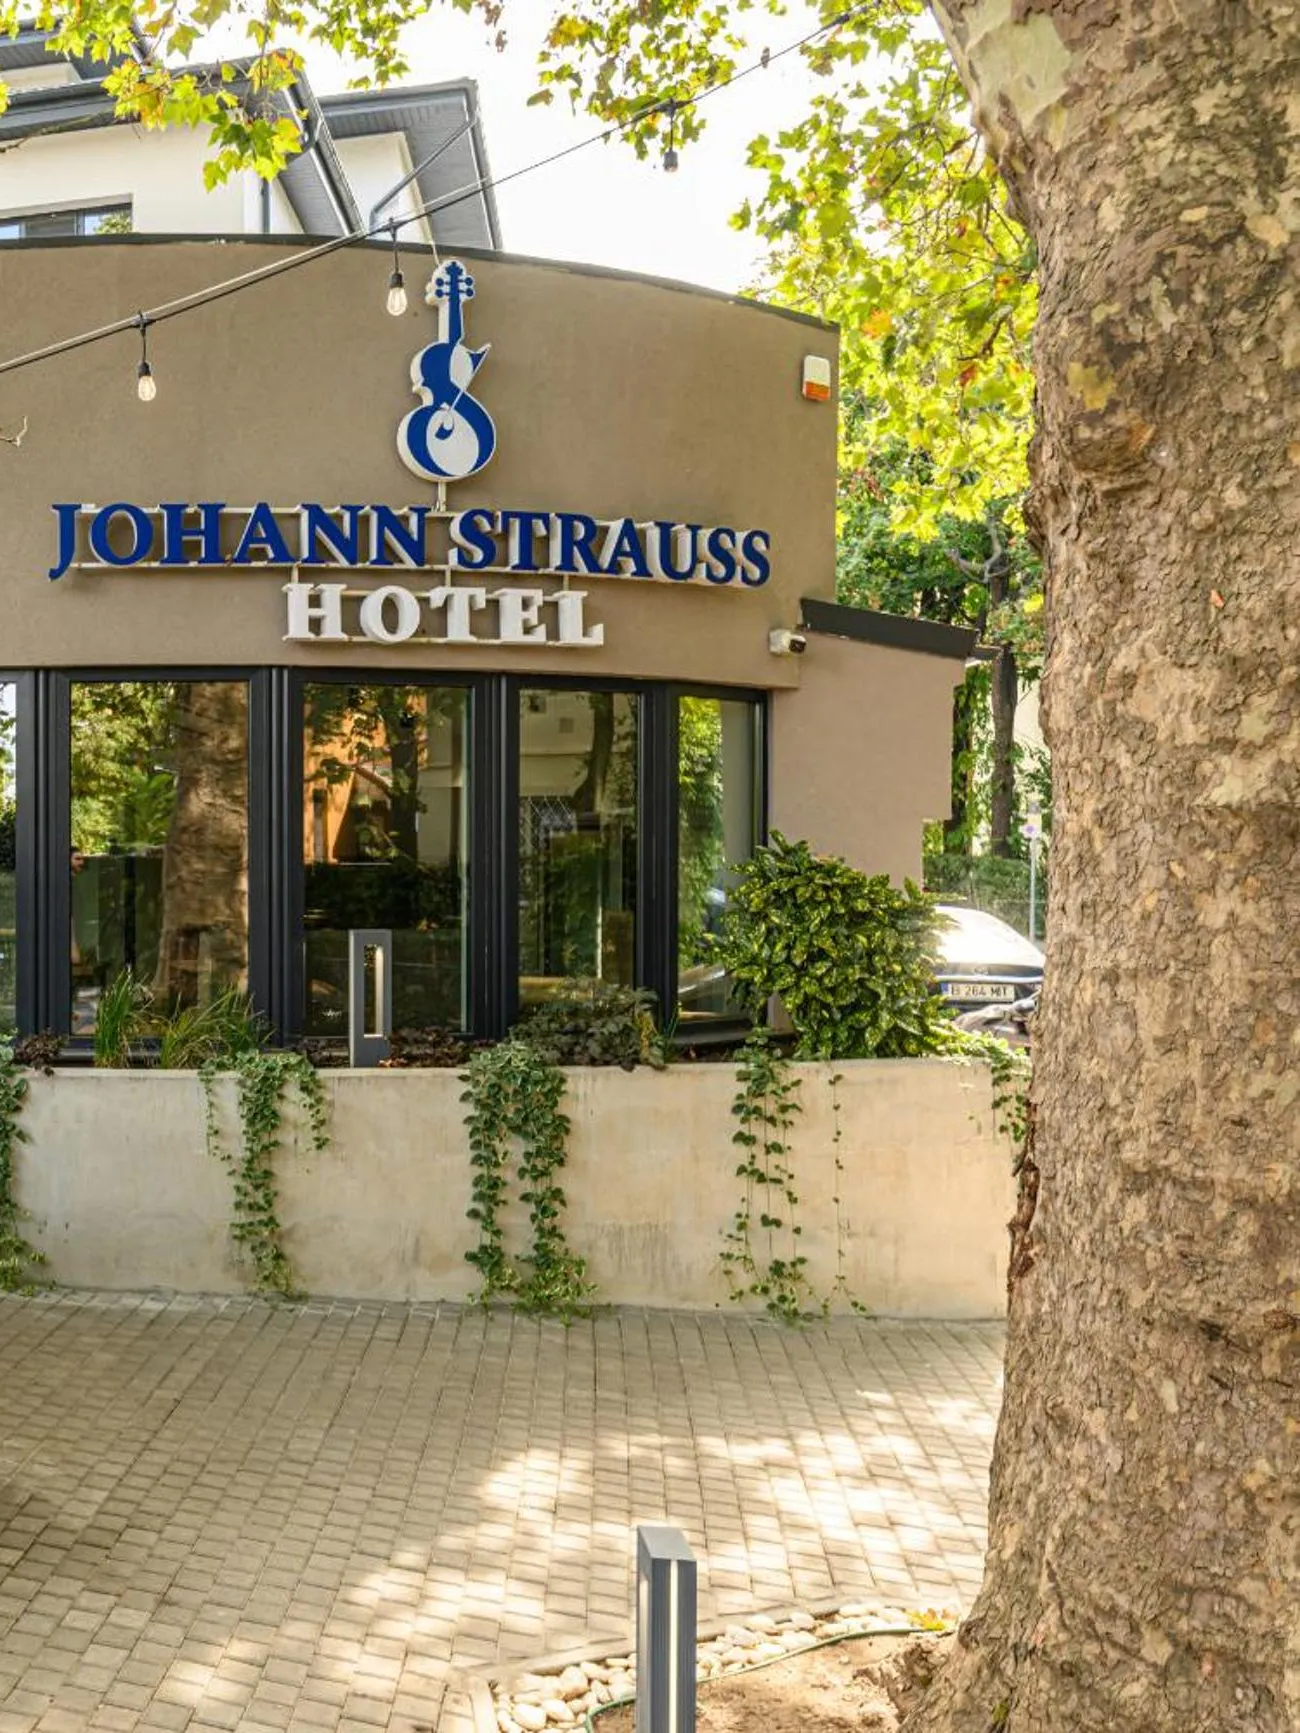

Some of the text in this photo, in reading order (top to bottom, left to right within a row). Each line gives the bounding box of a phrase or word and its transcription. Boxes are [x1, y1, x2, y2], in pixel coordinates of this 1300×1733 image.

[48, 502, 771, 588] JOHANN STRAUSS
[282, 583, 604, 645] HOTEL
